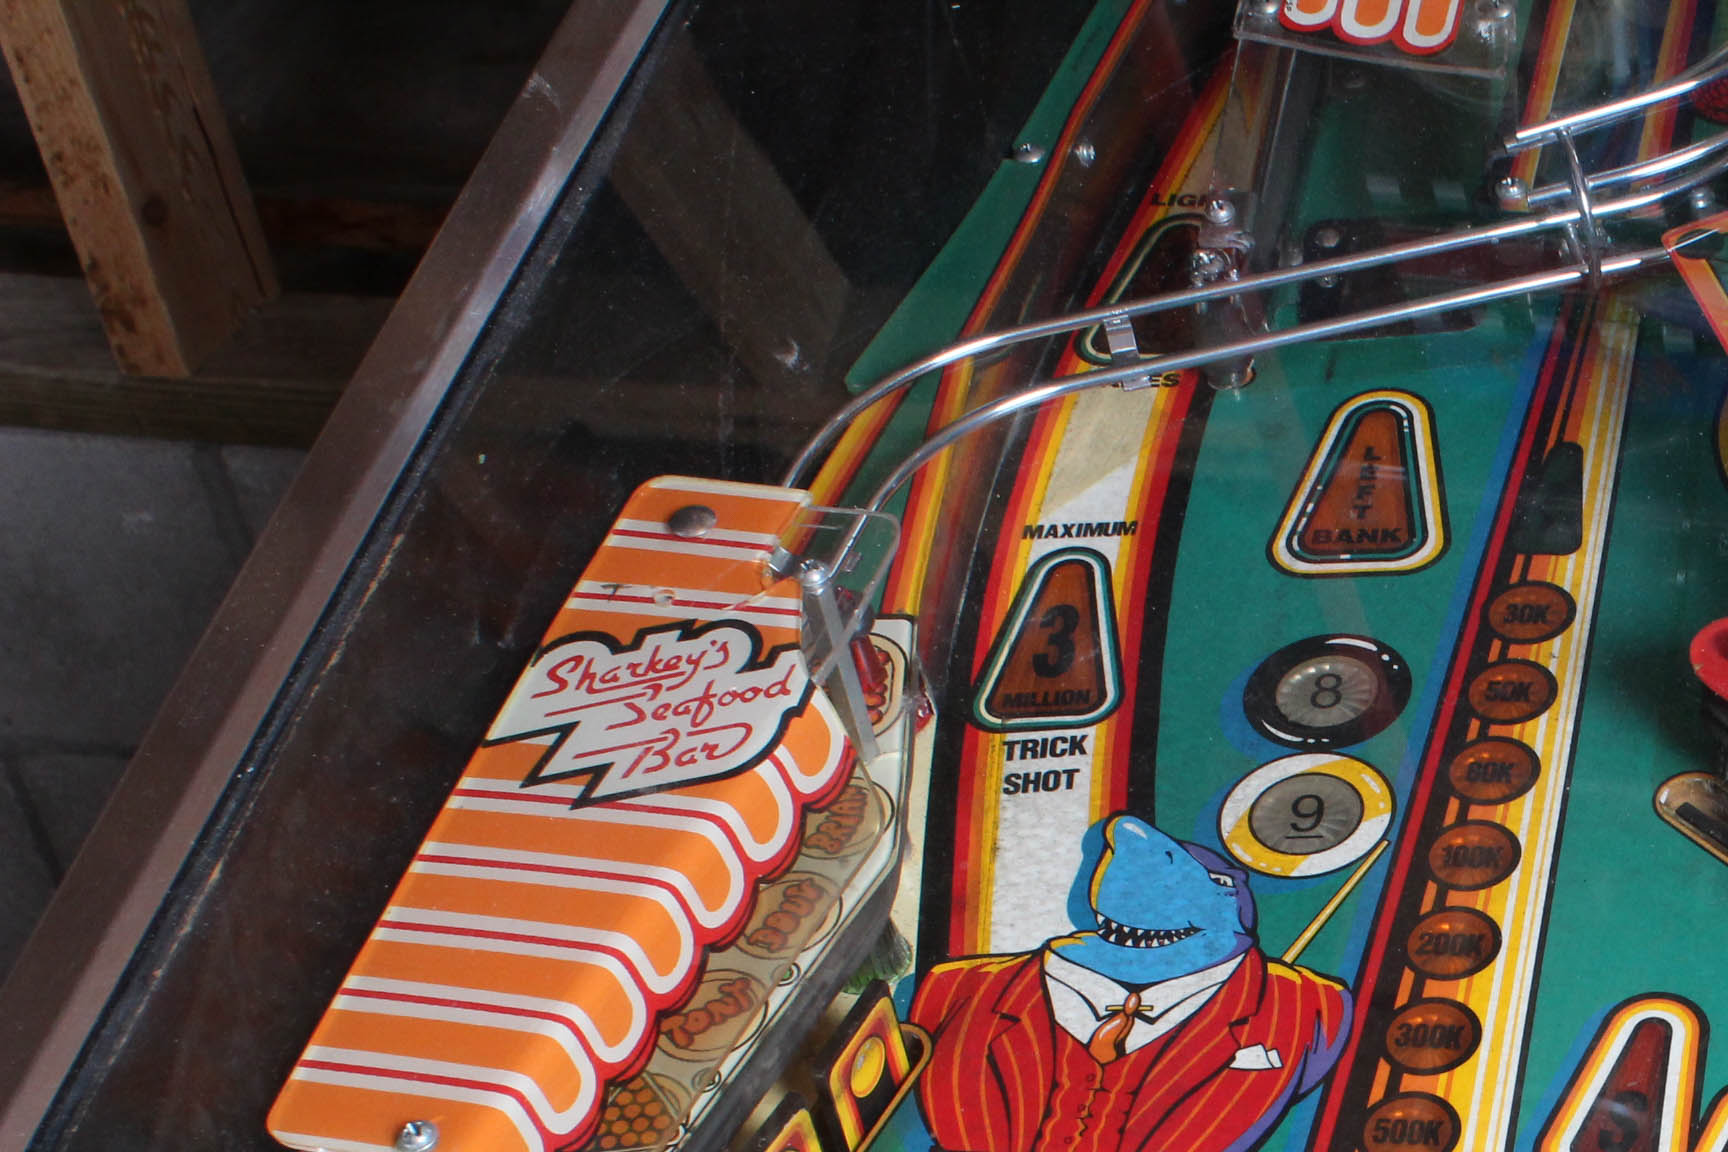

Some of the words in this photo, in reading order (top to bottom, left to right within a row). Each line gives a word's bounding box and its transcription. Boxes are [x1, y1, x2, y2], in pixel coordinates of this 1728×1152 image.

[1021, 520, 1139, 541] MAXIMUM
[1311, 527, 1404, 546] BANK
[1503, 603, 1551, 625] 30K
[1031, 604, 1080, 678] 3
[530, 638, 730, 699] Sharkey's
[545, 664, 797, 730] Seafood
[1002, 689, 1093, 709] MILLION
[1309, 673, 1343, 709] 8
[600, 723, 748, 779] Bar
[1003, 734, 1088, 762] TRICK
[1002, 768, 1081, 796] SHOT
[1287, 793, 1325, 839] 9
[1415, 933, 1484, 958] 200K
[1394, 1023, 1466, 1050] 300K
[1372, 1119, 1446, 1147] 500K
